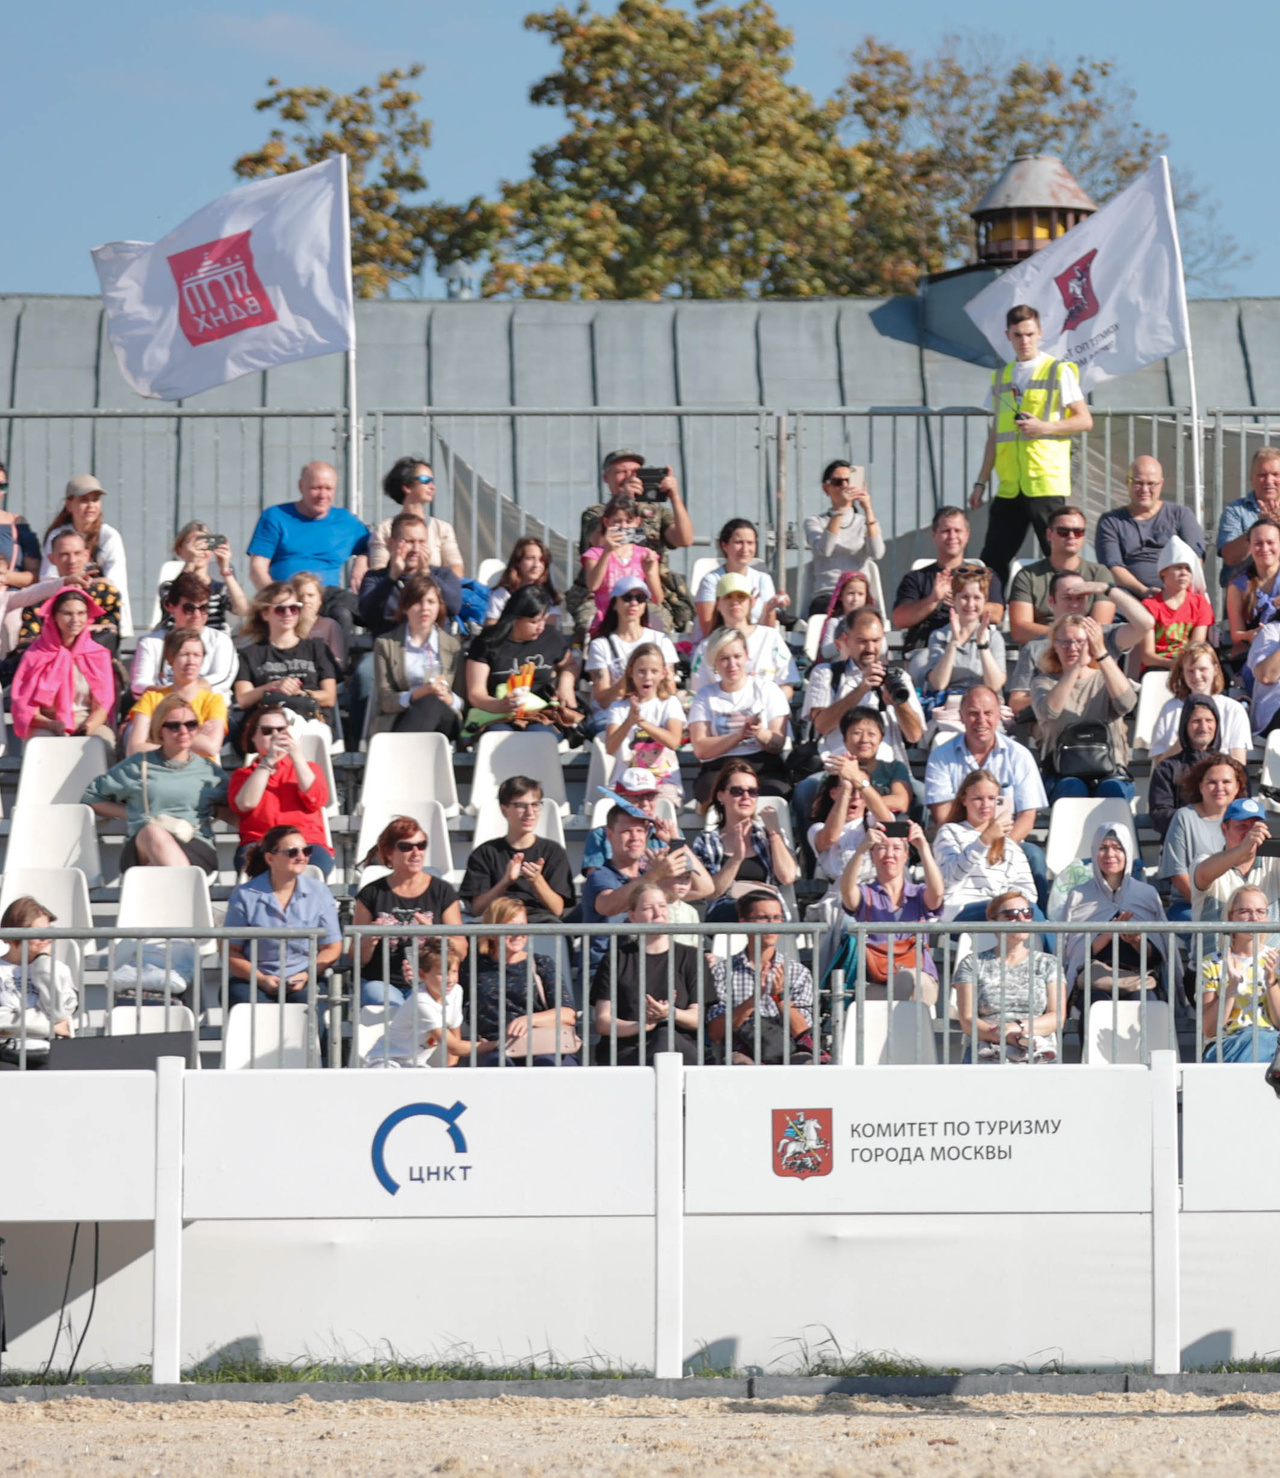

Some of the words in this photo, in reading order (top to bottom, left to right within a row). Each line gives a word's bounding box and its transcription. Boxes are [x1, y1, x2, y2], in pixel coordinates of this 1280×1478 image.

[850, 1121, 939, 1139] КОМИТЕТ
[943, 1121, 971, 1137] ПО
[974, 1119, 1062, 1136] ТУРИЗМУ
[851, 1147, 926, 1166] ГОРОДА
[930, 1145, 1013, 1162] МОСКВЫ
[409, 1165, 473, 1184] ЦНКТ
